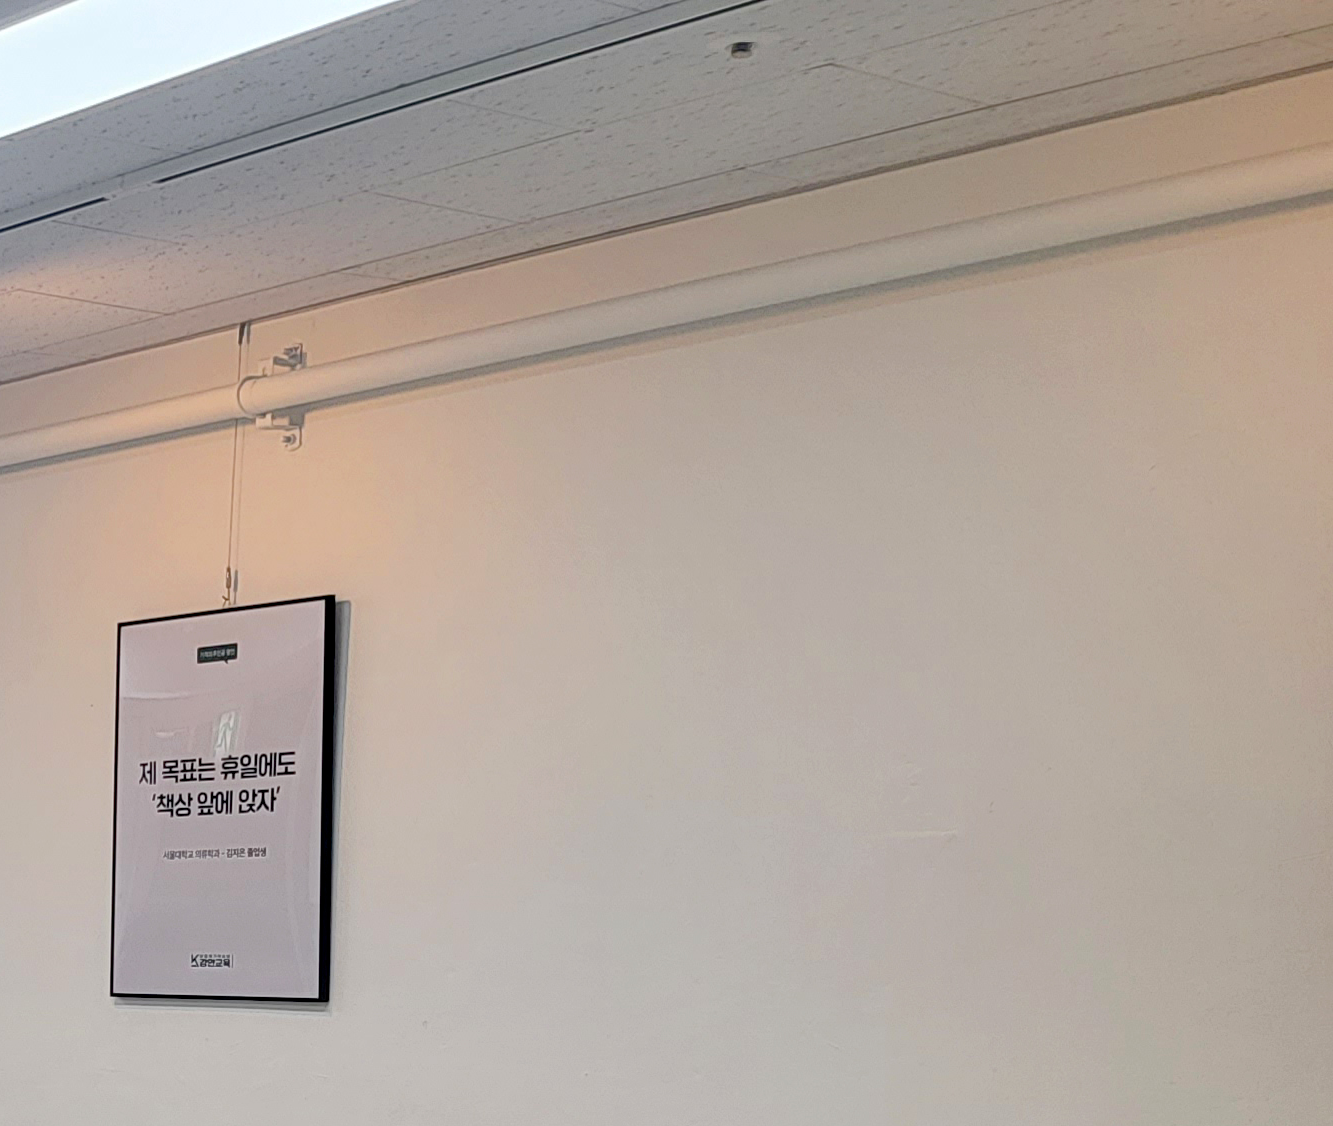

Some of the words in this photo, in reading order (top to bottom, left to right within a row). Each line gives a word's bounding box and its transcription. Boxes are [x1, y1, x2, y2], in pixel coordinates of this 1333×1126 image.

[139, 761, 157, 785] 제
[162, 758, 216, 783] 목표는
[220, 751, 297, 780] 휴일에도
[197, 790, 233, 816] 앞에
[163, 849, 194, 860] 서울대학교
